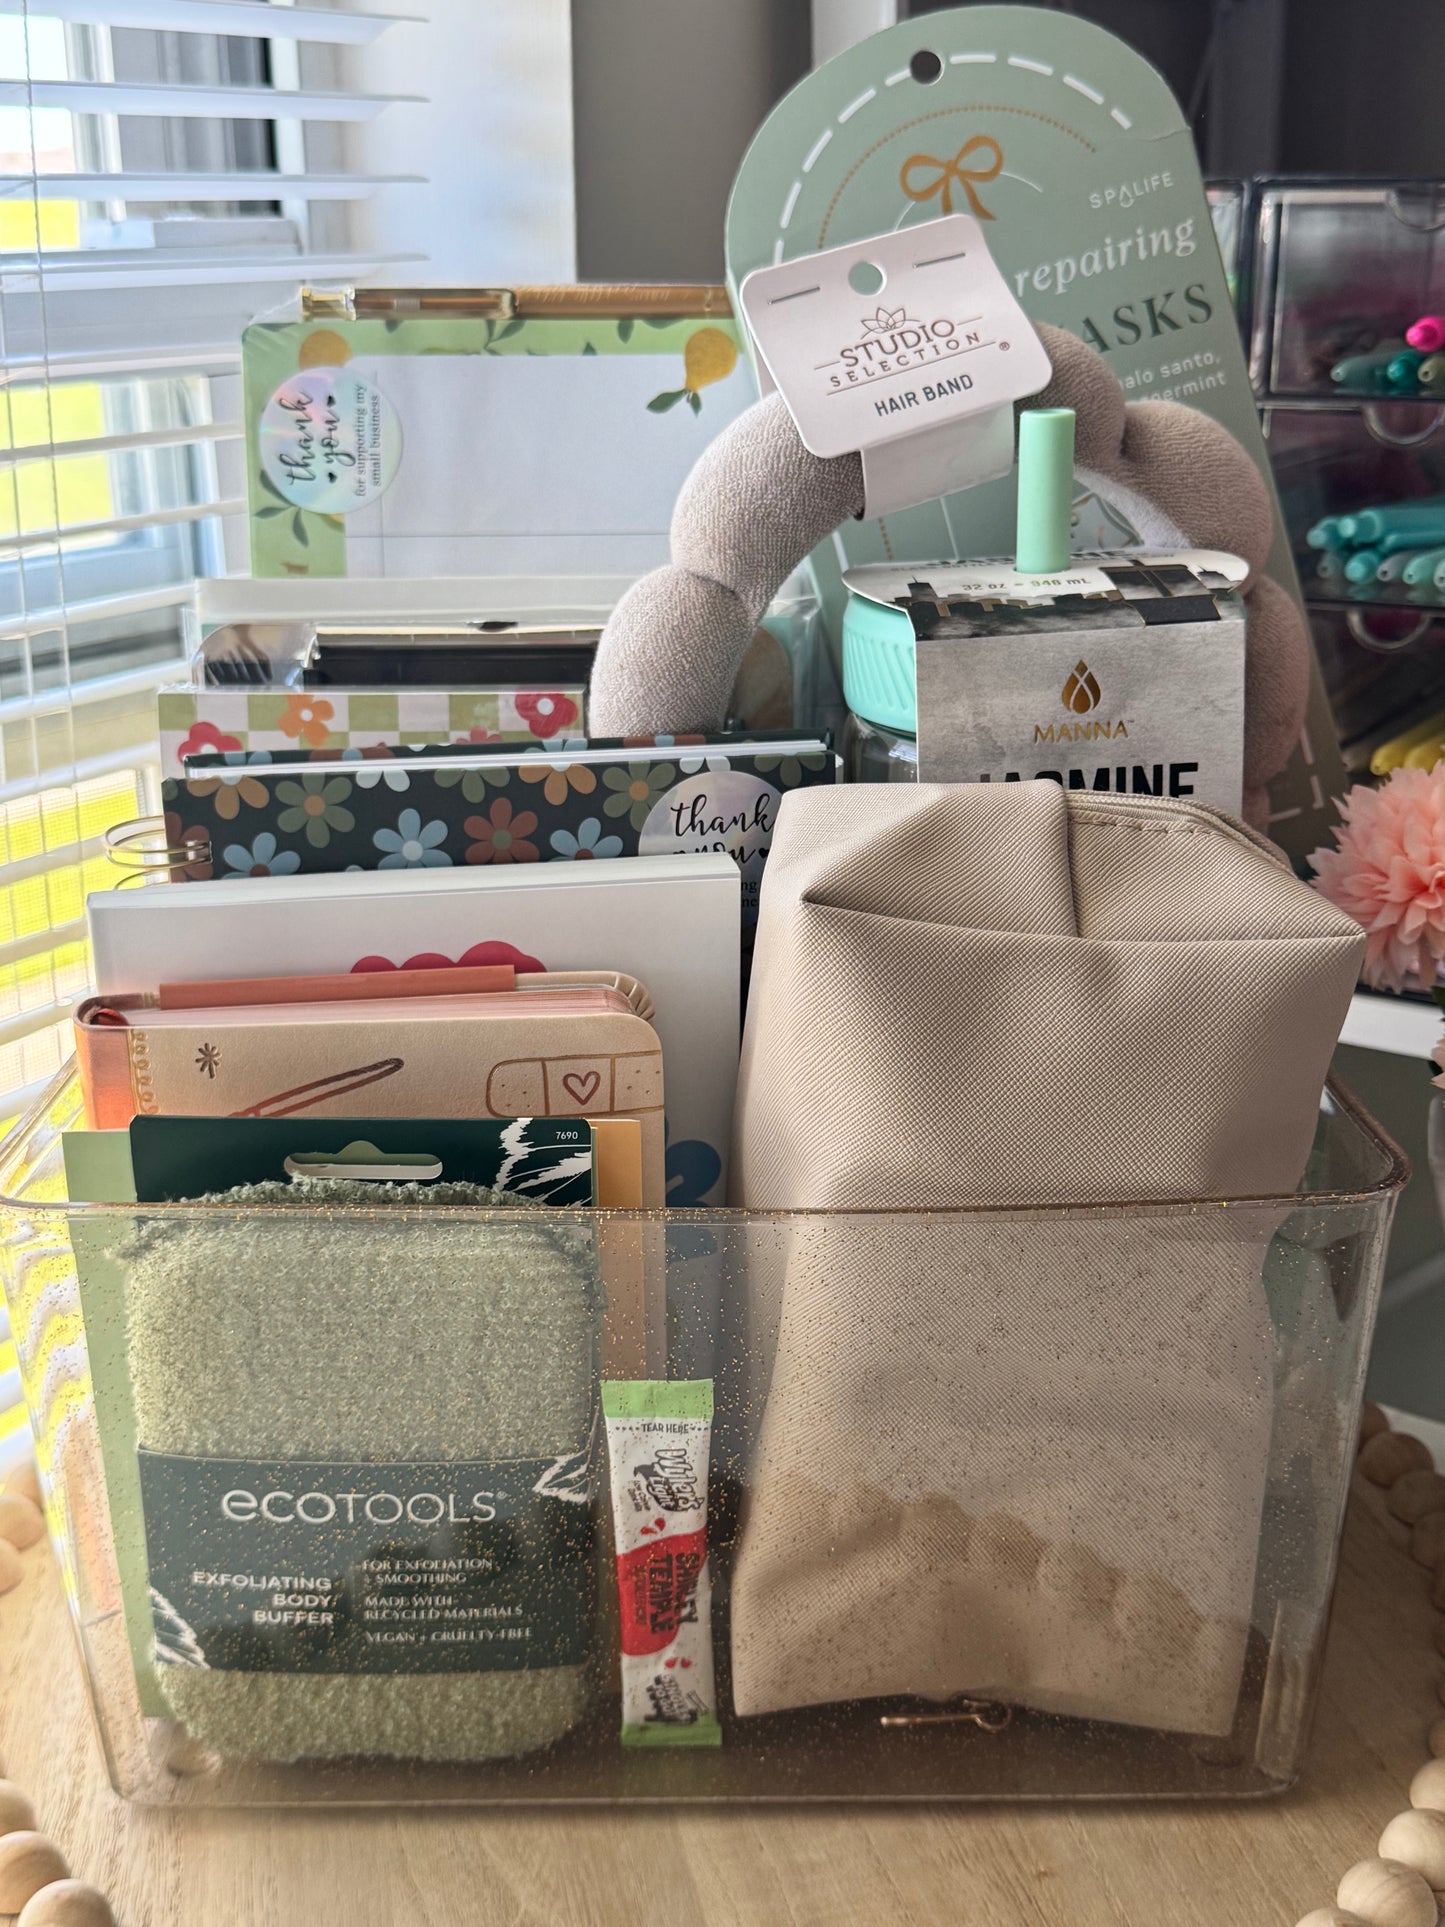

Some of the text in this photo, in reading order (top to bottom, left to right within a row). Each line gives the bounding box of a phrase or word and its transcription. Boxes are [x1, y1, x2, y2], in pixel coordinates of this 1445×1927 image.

[1014, 218, 1197, 298] repairing
[1081, 283, 1213, 354] ASKS
[840, 319, 956, 368] STUDIO
[830, 332, 981, 388] SELECTION
[1160, 352, 1222, 379] santo,
[874, 374, 974, 417] HAIR BAND
[278, 391, 317, 485] thank
[320, 410, 356, 467] you
[354, 385, 368, 497] for supporting my
[370, 394, 382, 486] small business
[1034, 720, 1130, 745] MANNA
[670, 793, 776, 837] thank
[556, 1131, 578, 1140] 7690
[641, 1423, 690, 1434] TEAR HERE
[362, 1558, 493, 1571] FOR EXFOLIATION
[192, 1571, 333, 1591] EXFOLIATING
[376, 1573, 467, 1584] SMOOTHING
[273, 1593, 332, 1608] BODY
[364, 1605, 523, 1620] RECYCLED MATERIALS
[365, 1596, 453, 1607] MADE WITH
[254, 1610, 334, 1625] BUFFER
[365, 1631, 415, 1643] VEGAN
